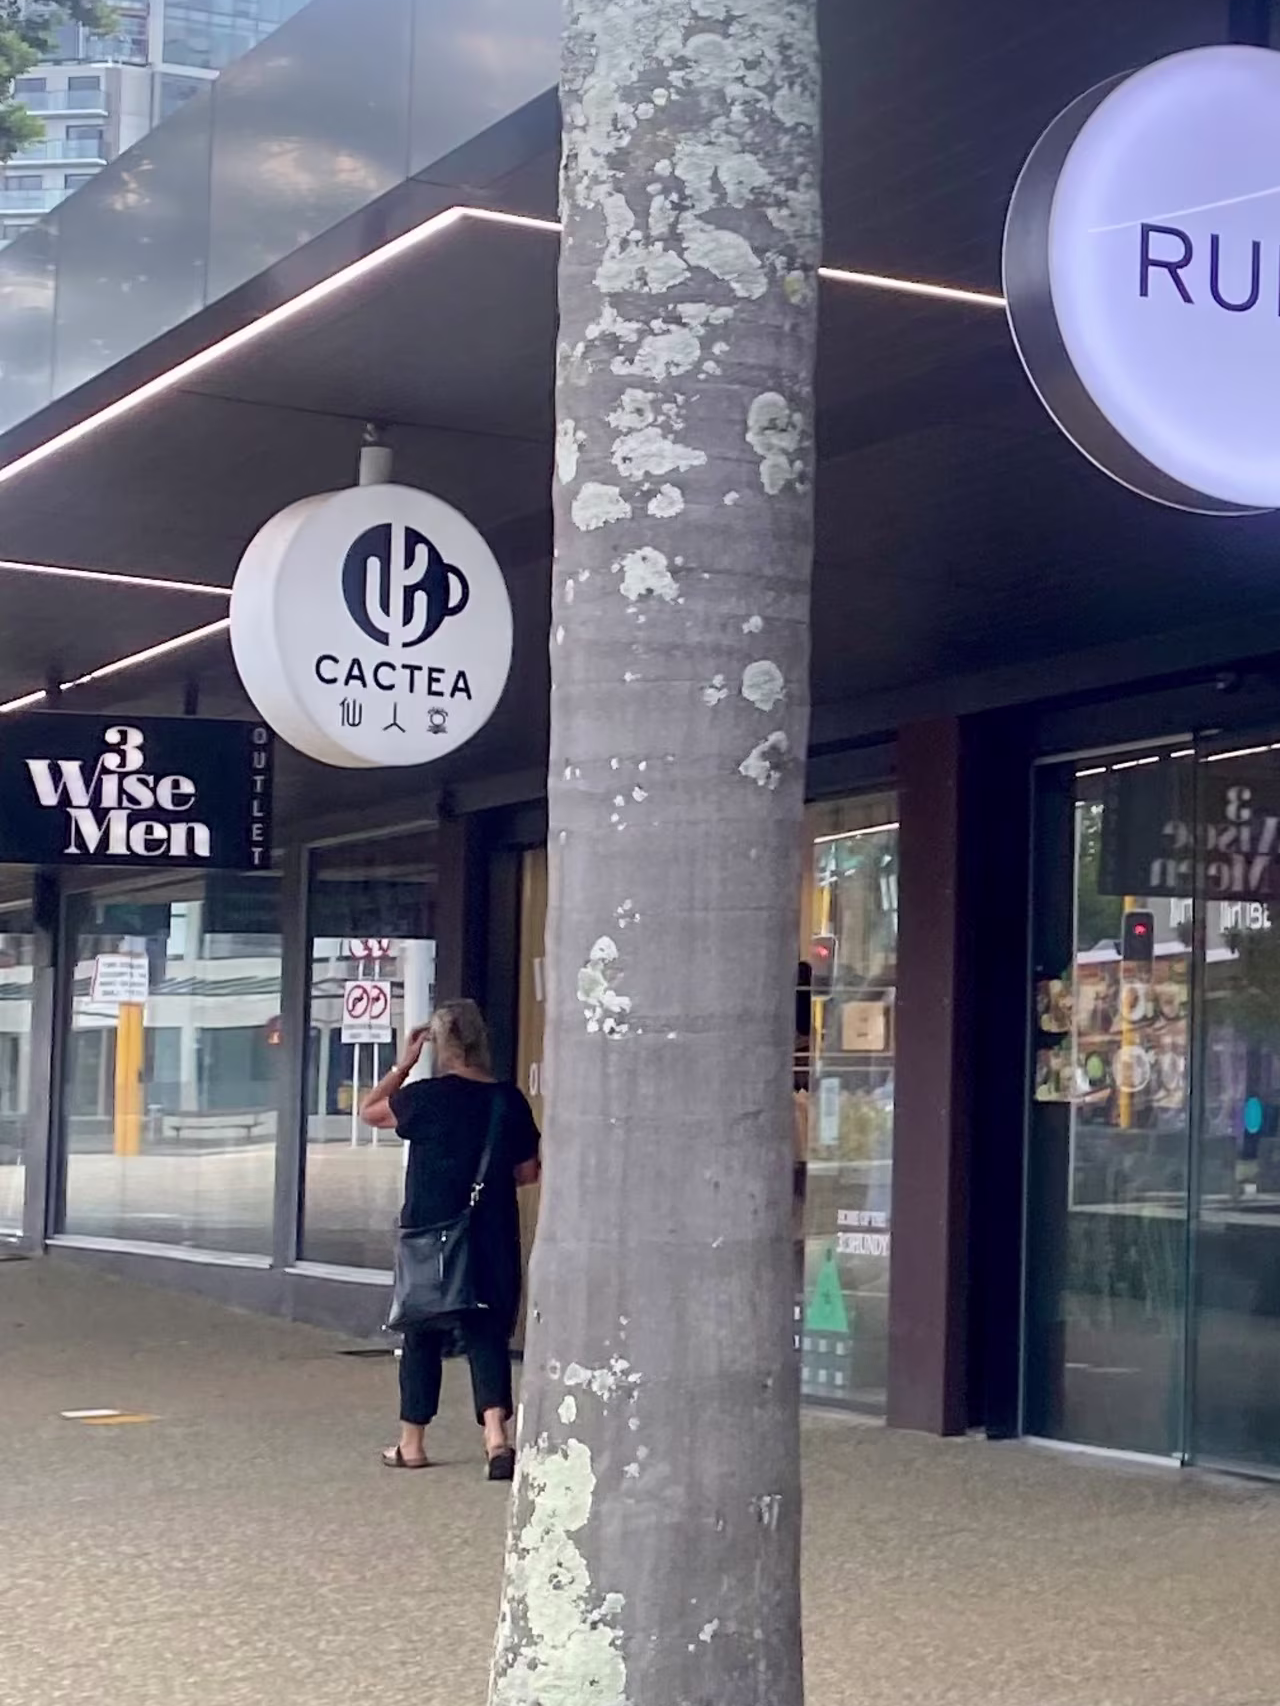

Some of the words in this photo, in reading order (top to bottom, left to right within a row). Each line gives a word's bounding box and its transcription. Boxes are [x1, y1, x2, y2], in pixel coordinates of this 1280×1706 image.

[314, 653, 473, 701] CACTEA
[103, 725, 144, 773] 3
[25, 754, 196, 811] Wise
[251, 727, 268, 866] OUTLET
[64, 807, 211, 857] Men
